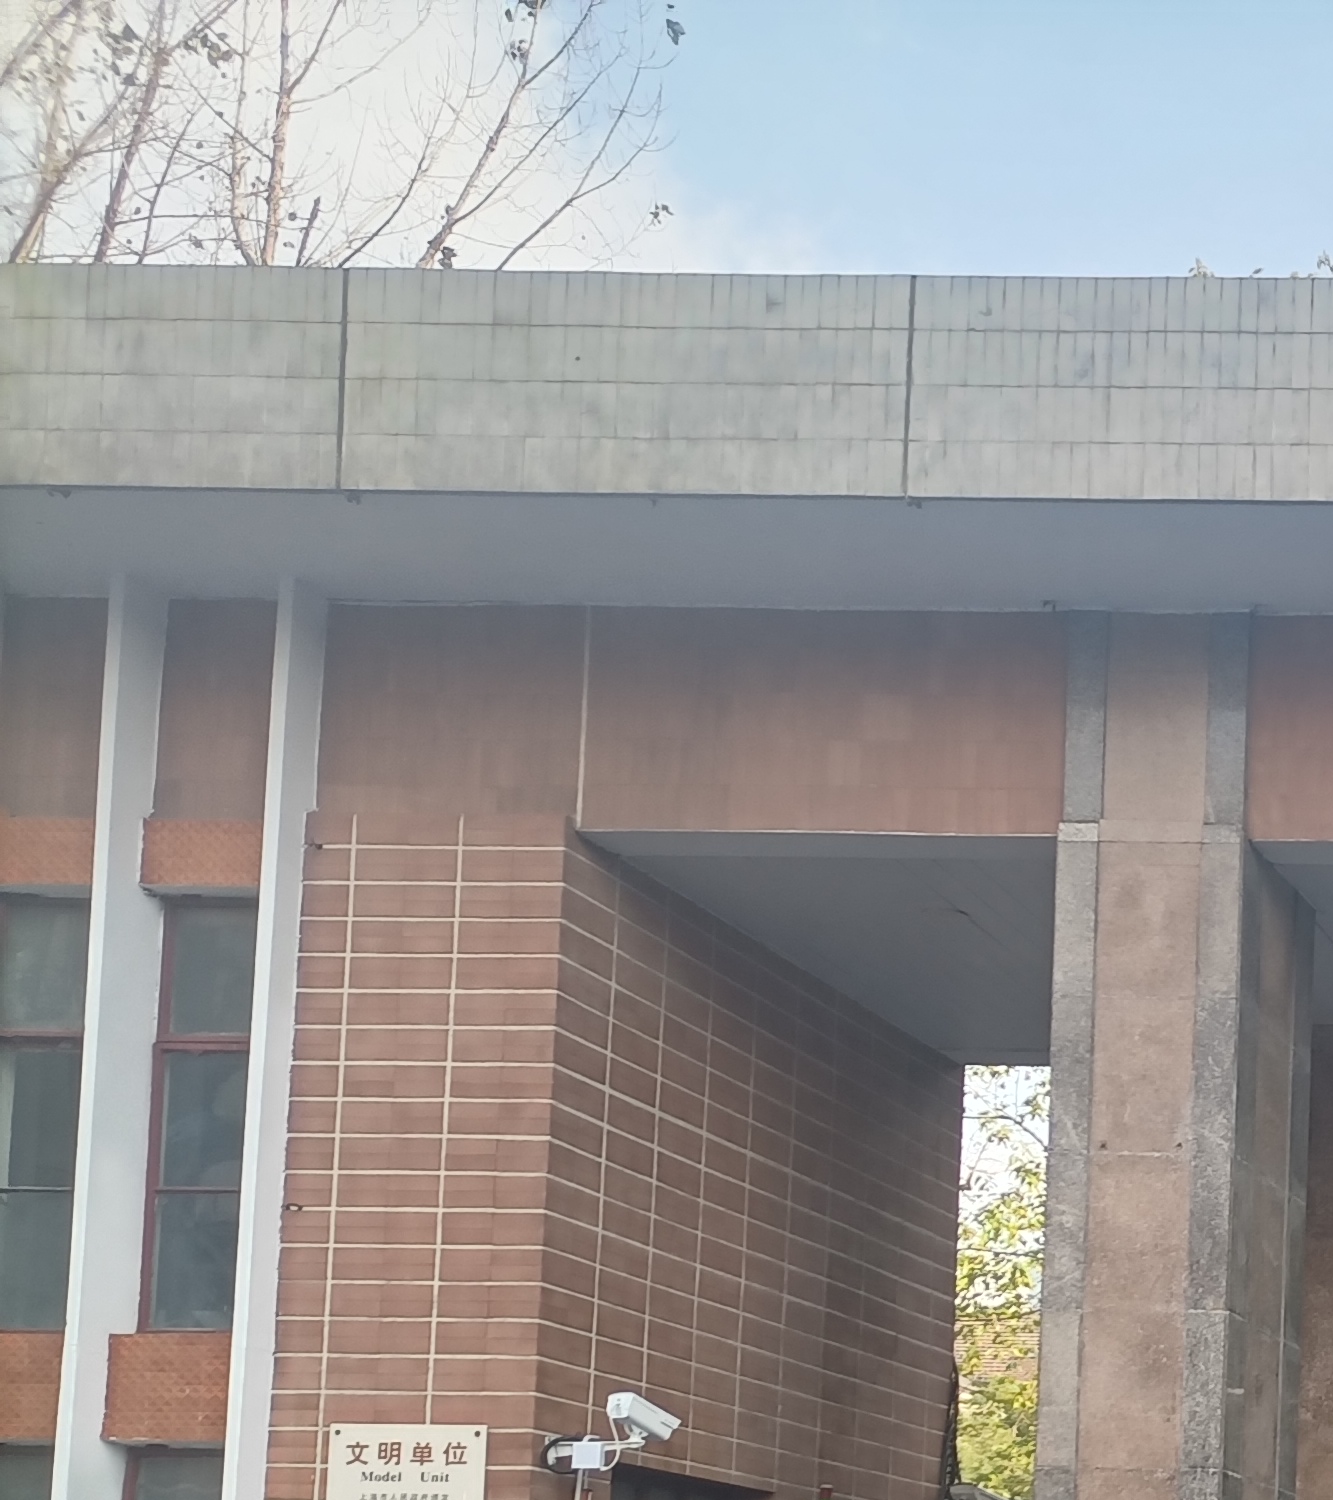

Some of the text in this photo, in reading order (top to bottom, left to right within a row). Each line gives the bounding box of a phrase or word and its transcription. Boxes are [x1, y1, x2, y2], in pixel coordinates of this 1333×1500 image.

[345, 1441, 468, 1466] 文明单位
[360, 1471, 450, 1482] Model Unit
